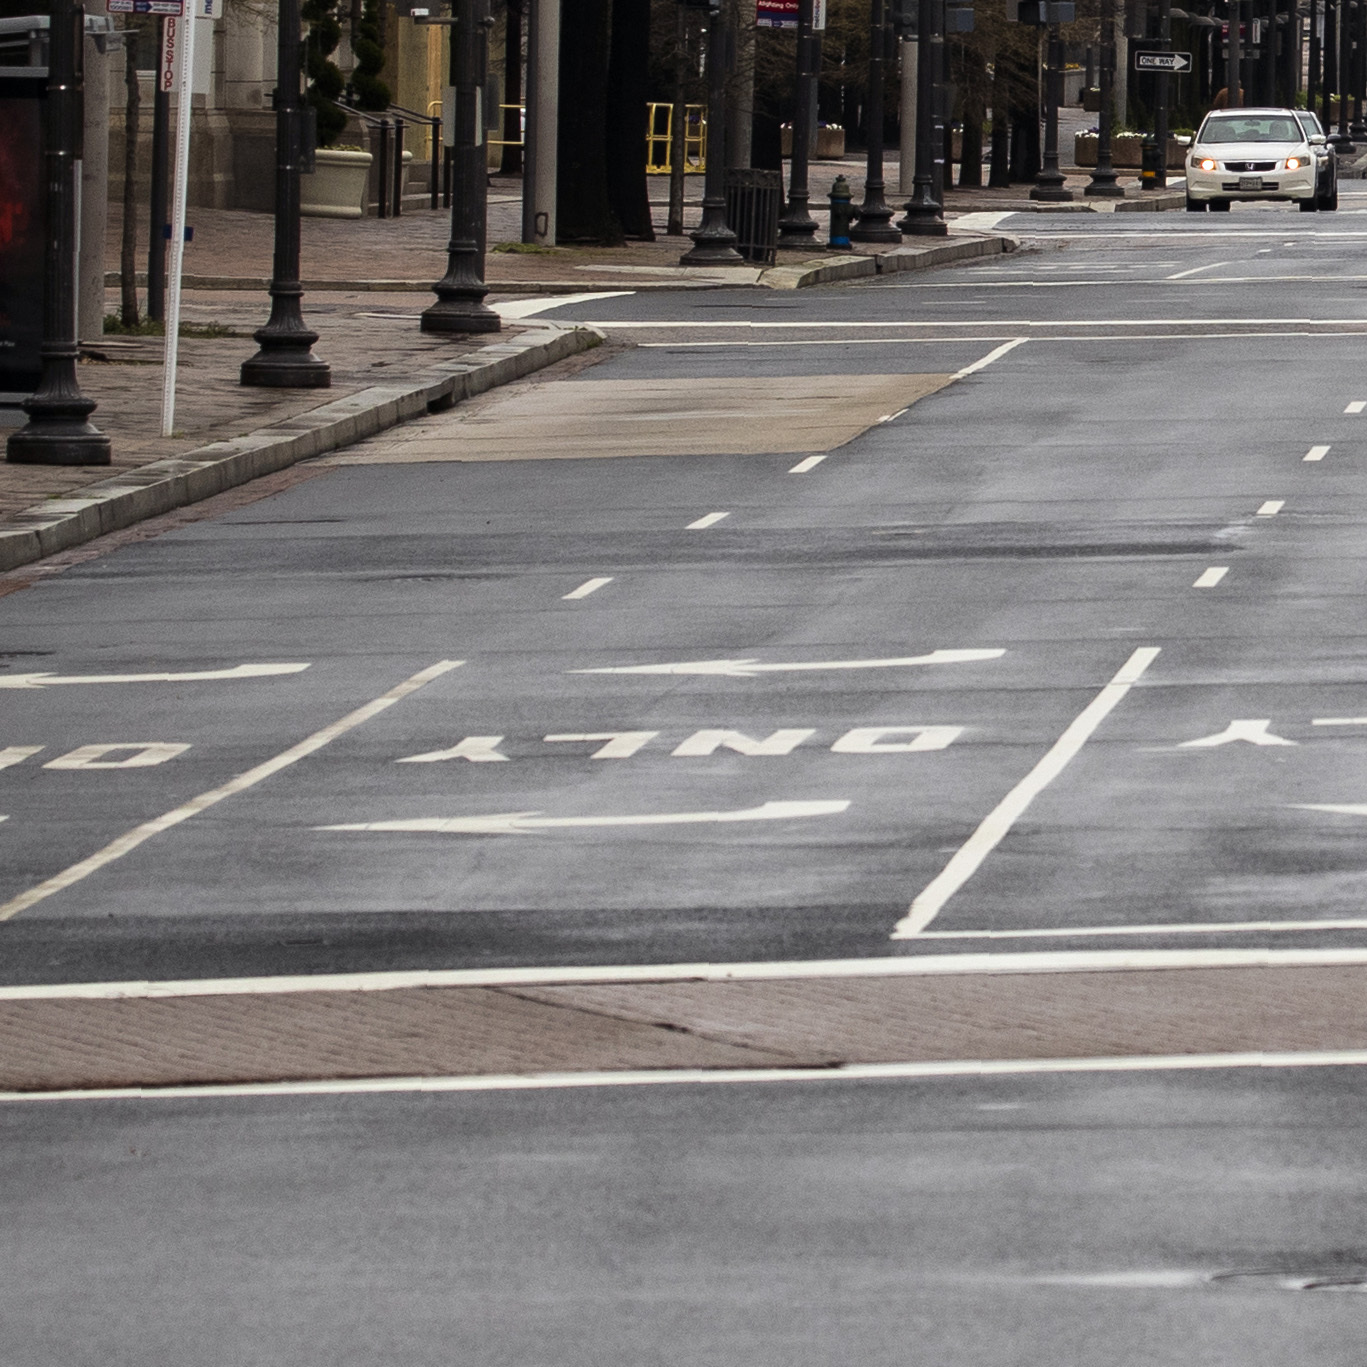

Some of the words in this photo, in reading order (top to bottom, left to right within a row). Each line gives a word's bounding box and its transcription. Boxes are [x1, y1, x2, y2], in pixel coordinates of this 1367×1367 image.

[167, 17, 176, 49] BUS
[164, 49, 174, 90] STOP
[1141, 56, 1156, 65] ONE
[1159, 57, 1175, 65] WAY
[395, 726, 966, 763] ONLY
